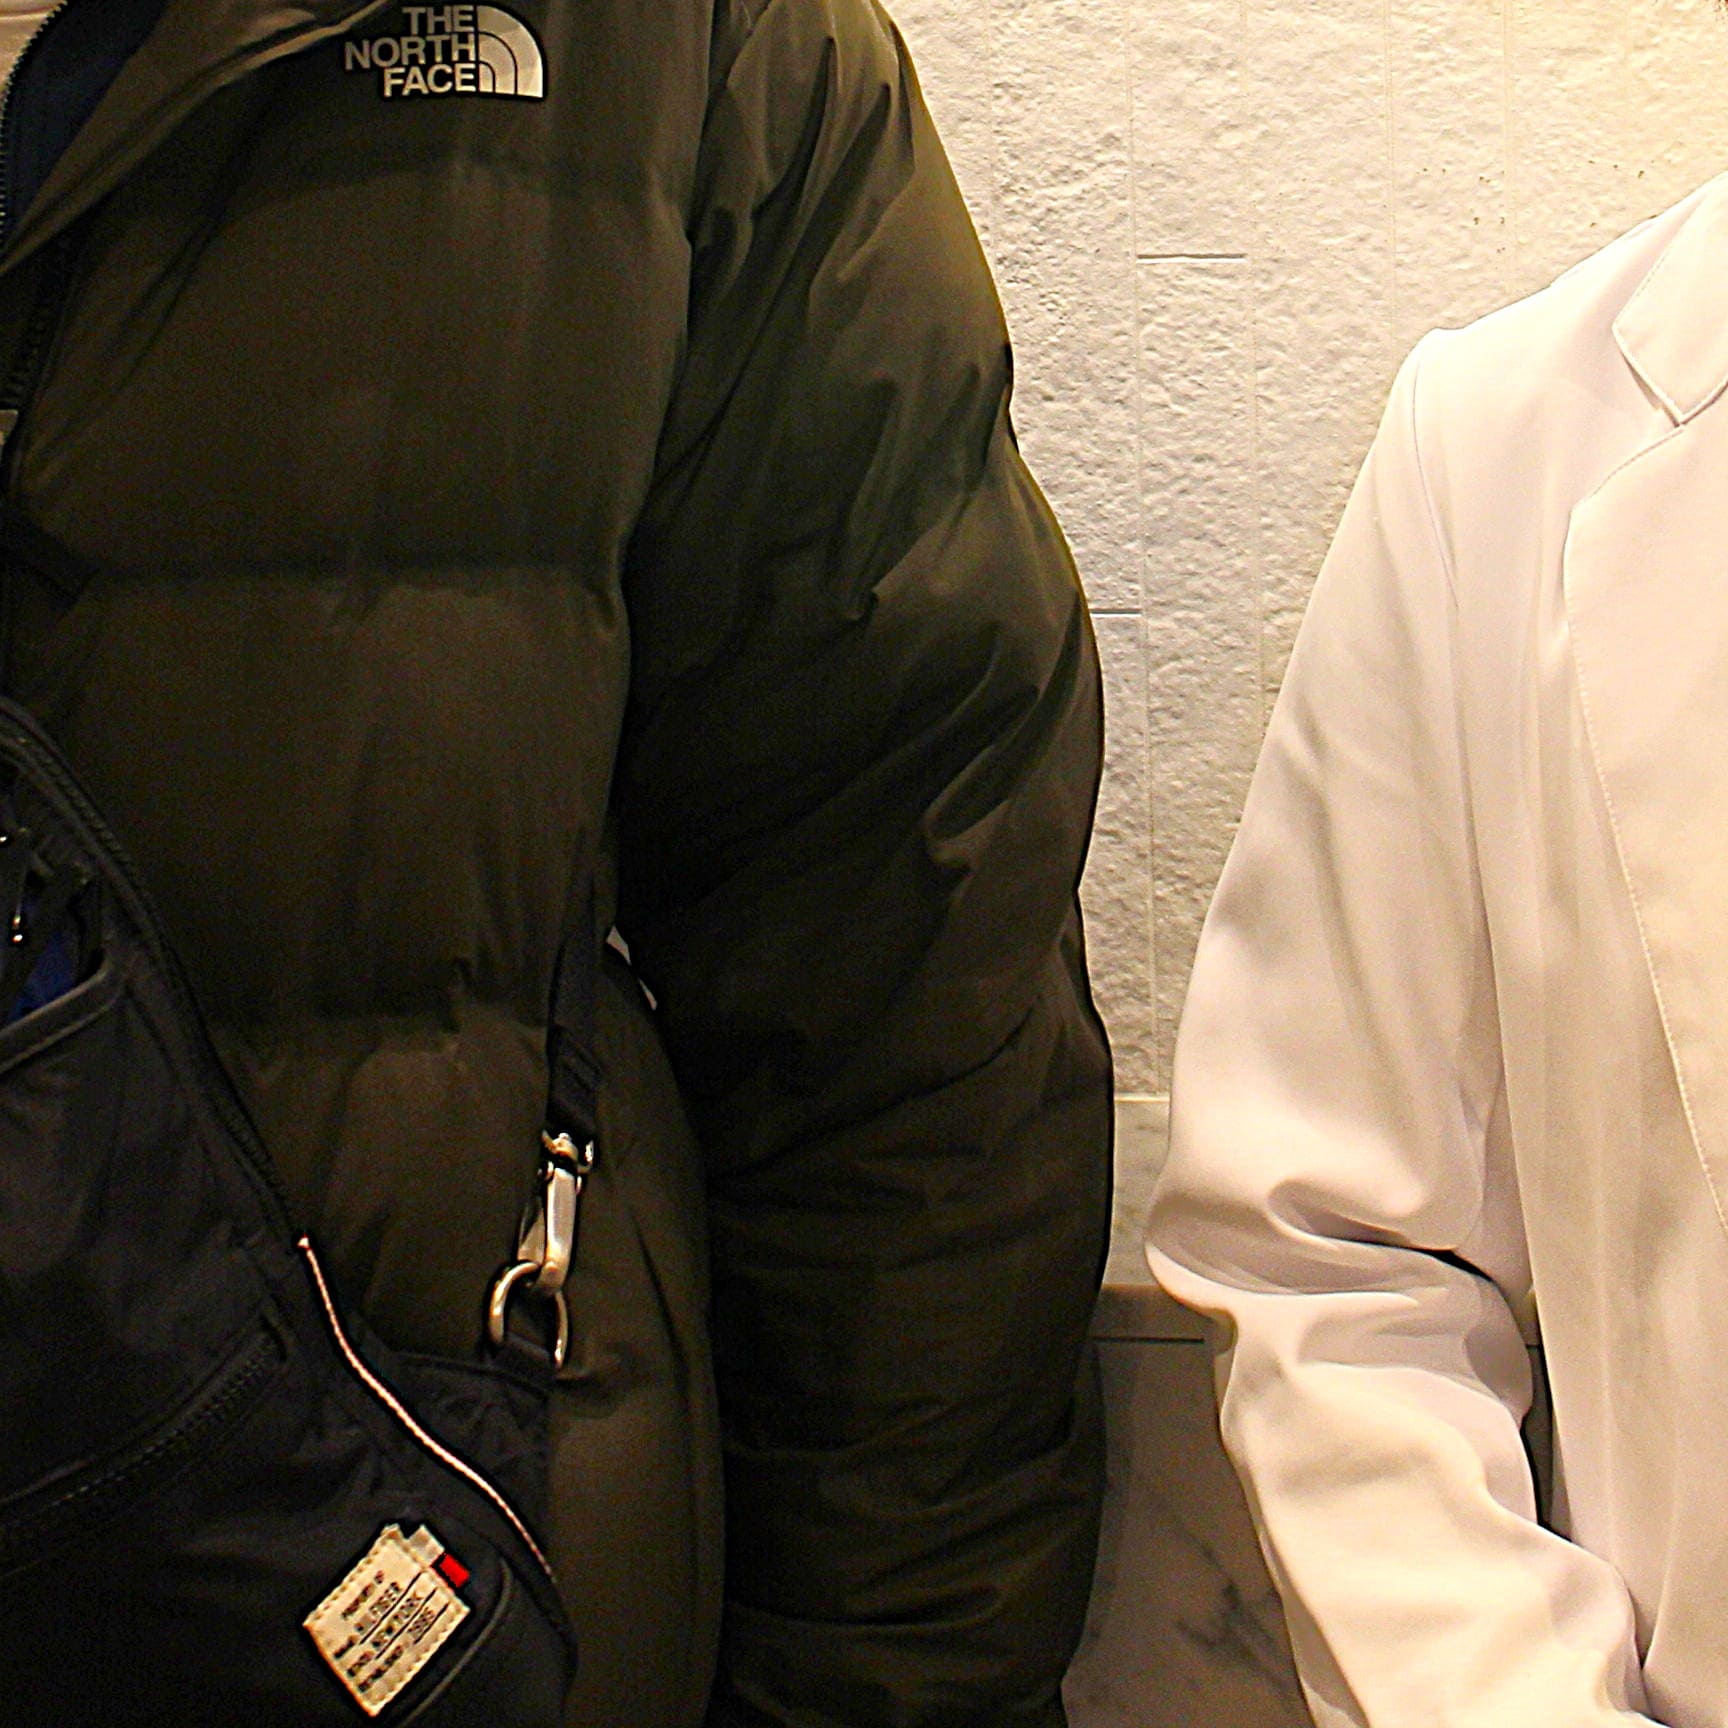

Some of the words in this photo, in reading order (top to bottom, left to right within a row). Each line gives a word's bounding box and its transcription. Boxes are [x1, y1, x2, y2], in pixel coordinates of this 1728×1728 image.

[402, 4, 475, 35] THE
[344, 34, 476, 71] NORTH
[383, 62, 477, 98] FACE
